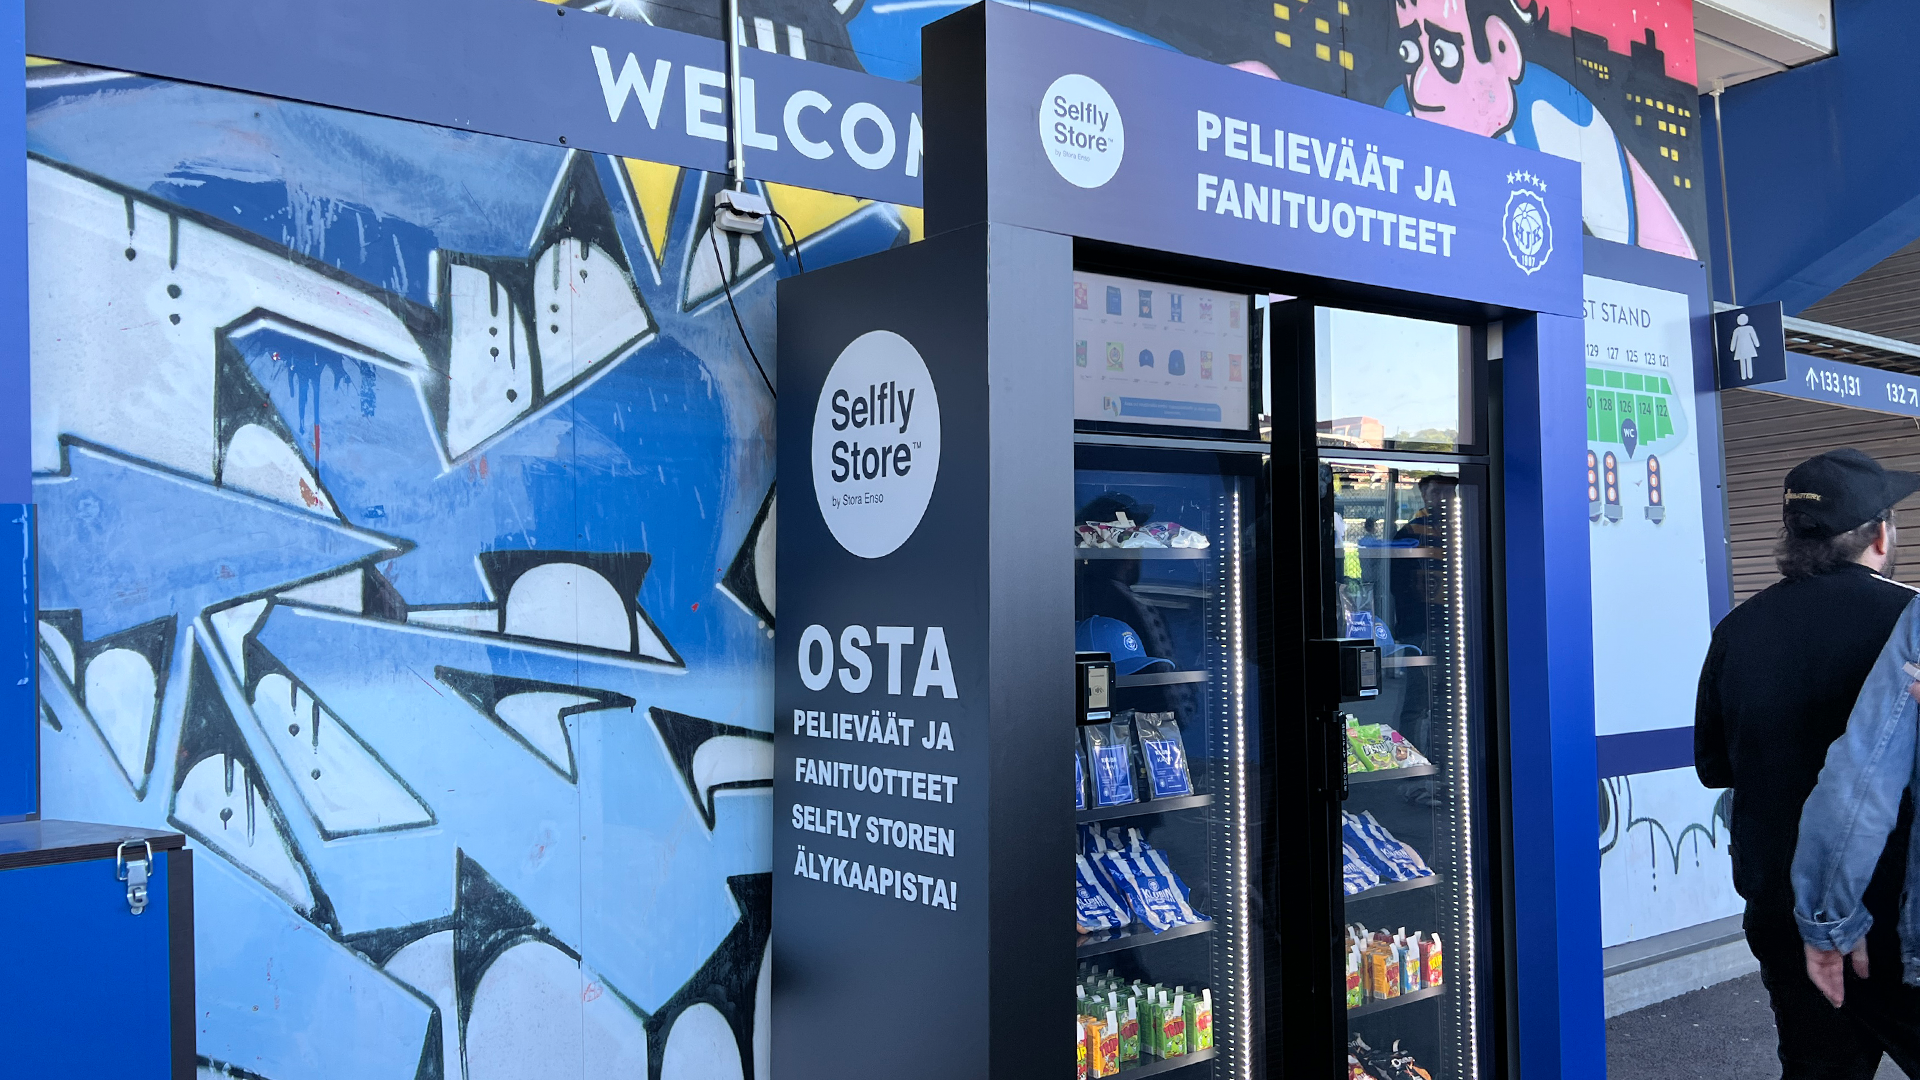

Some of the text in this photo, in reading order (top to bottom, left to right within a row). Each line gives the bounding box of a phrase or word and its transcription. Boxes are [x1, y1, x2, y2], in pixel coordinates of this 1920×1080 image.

[1054, 95, 1109, 132] Selfly
[1062, 150, 1077, 160] Stora
[1077, 154, 1091, 162] Enso
[1197, 110, 1458, 208] PELIEVÄÄT JA
[1197, 173, 1457, 258] FANITUOTTEET
[1601, 302, 1651, 328] STAND
[1586, 343, 1669, 367] 129 127 125 123 121
[1820, 370, 1906, 404] 133,131 132
[831, 381, 916, 434] Selfly
[1599, 398, 1613, 412] 128
[1619, 400, 1632, 413] 126
[1639, 402, 1651, 415] 124
[1656, 404, 1668, 417] 122
[1623, 428, 1635, 438] WC
[832, 492, 884, 509] by Stora Enso
[798, 624, 959, 699] OSTA
[793, 709, 955, 751] PELIEVÄÄT JA
[795, 757, 959, 804] FANITUOTTEET
[791, 803, 955, 857] SELFLY STOREN
[794, 844, 957, 911] ÄLYKAAPISTA!
